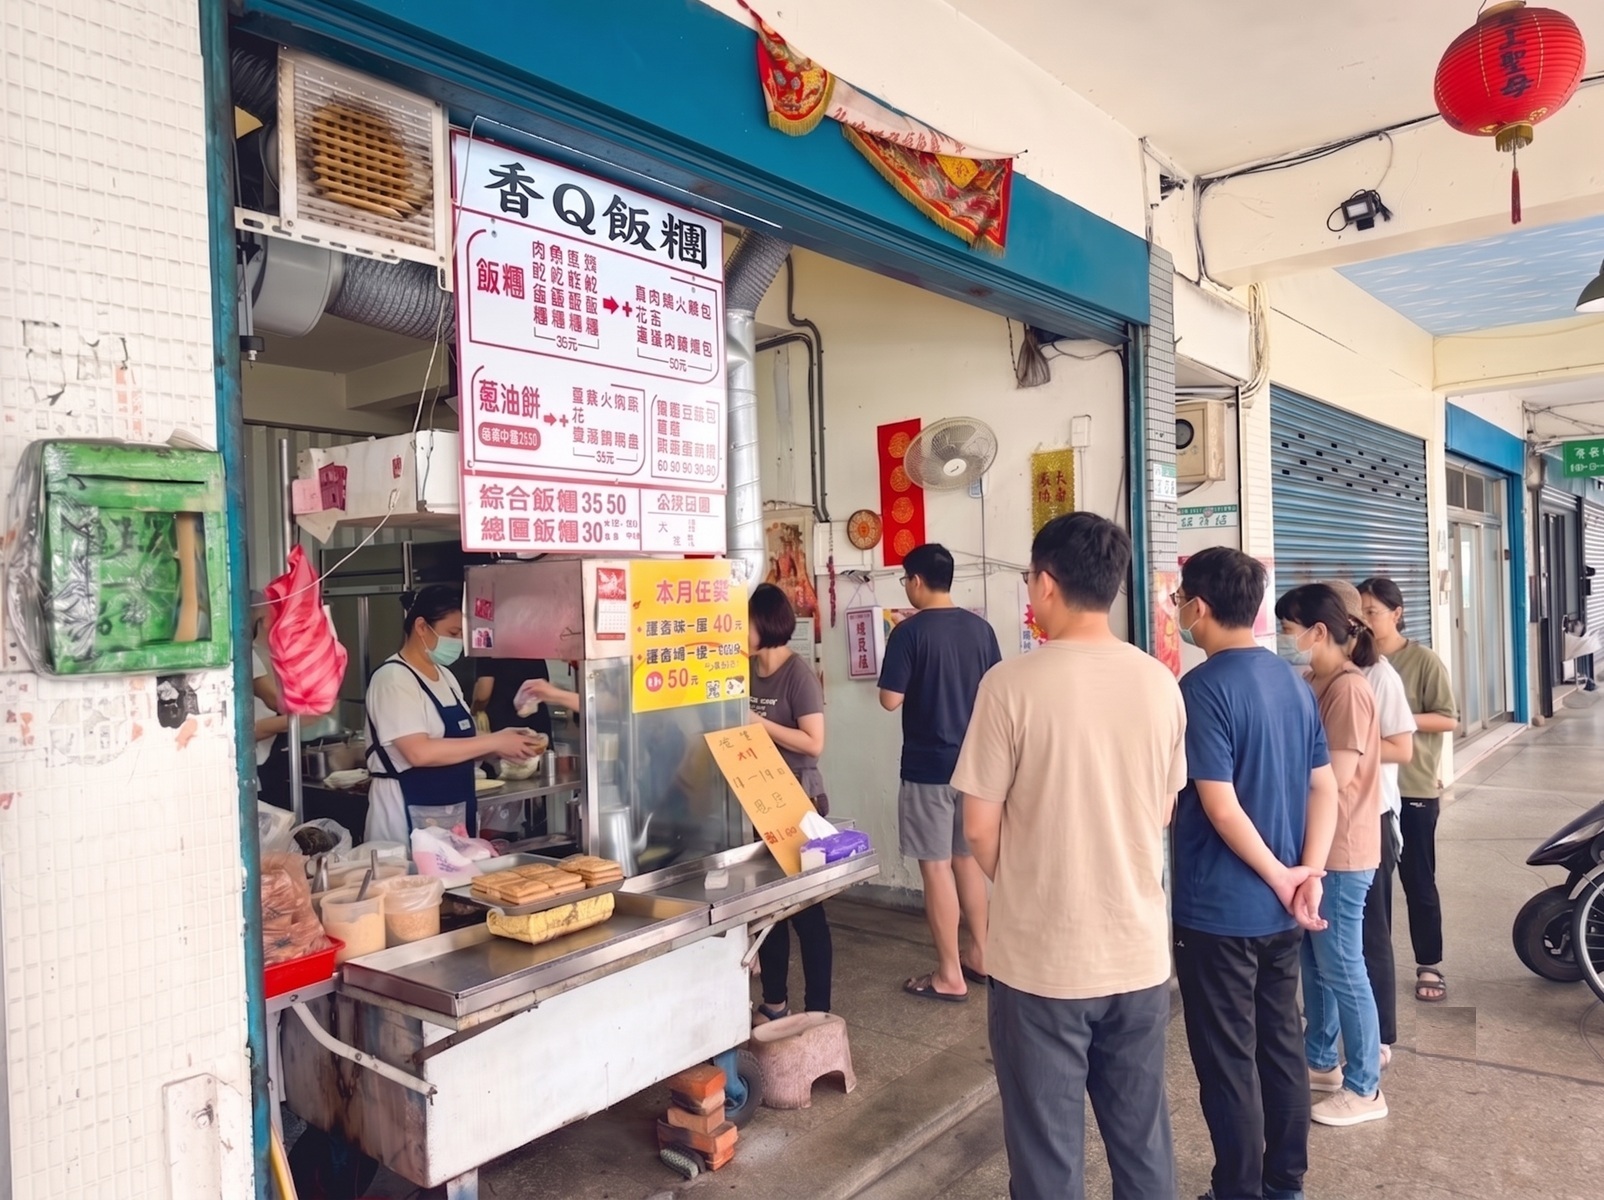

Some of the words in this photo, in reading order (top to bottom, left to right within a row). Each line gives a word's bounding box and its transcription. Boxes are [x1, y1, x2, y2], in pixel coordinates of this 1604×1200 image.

[484, 162, 707, 269] 香Q飯糰
[669, 357, 687, 372] 50元
[479, 379, 540, 419] 蔥油餅
[582, 491, 603, 514] 35
[606, 493, 626, 515] 50
[582, 521, 603, 543] 30
